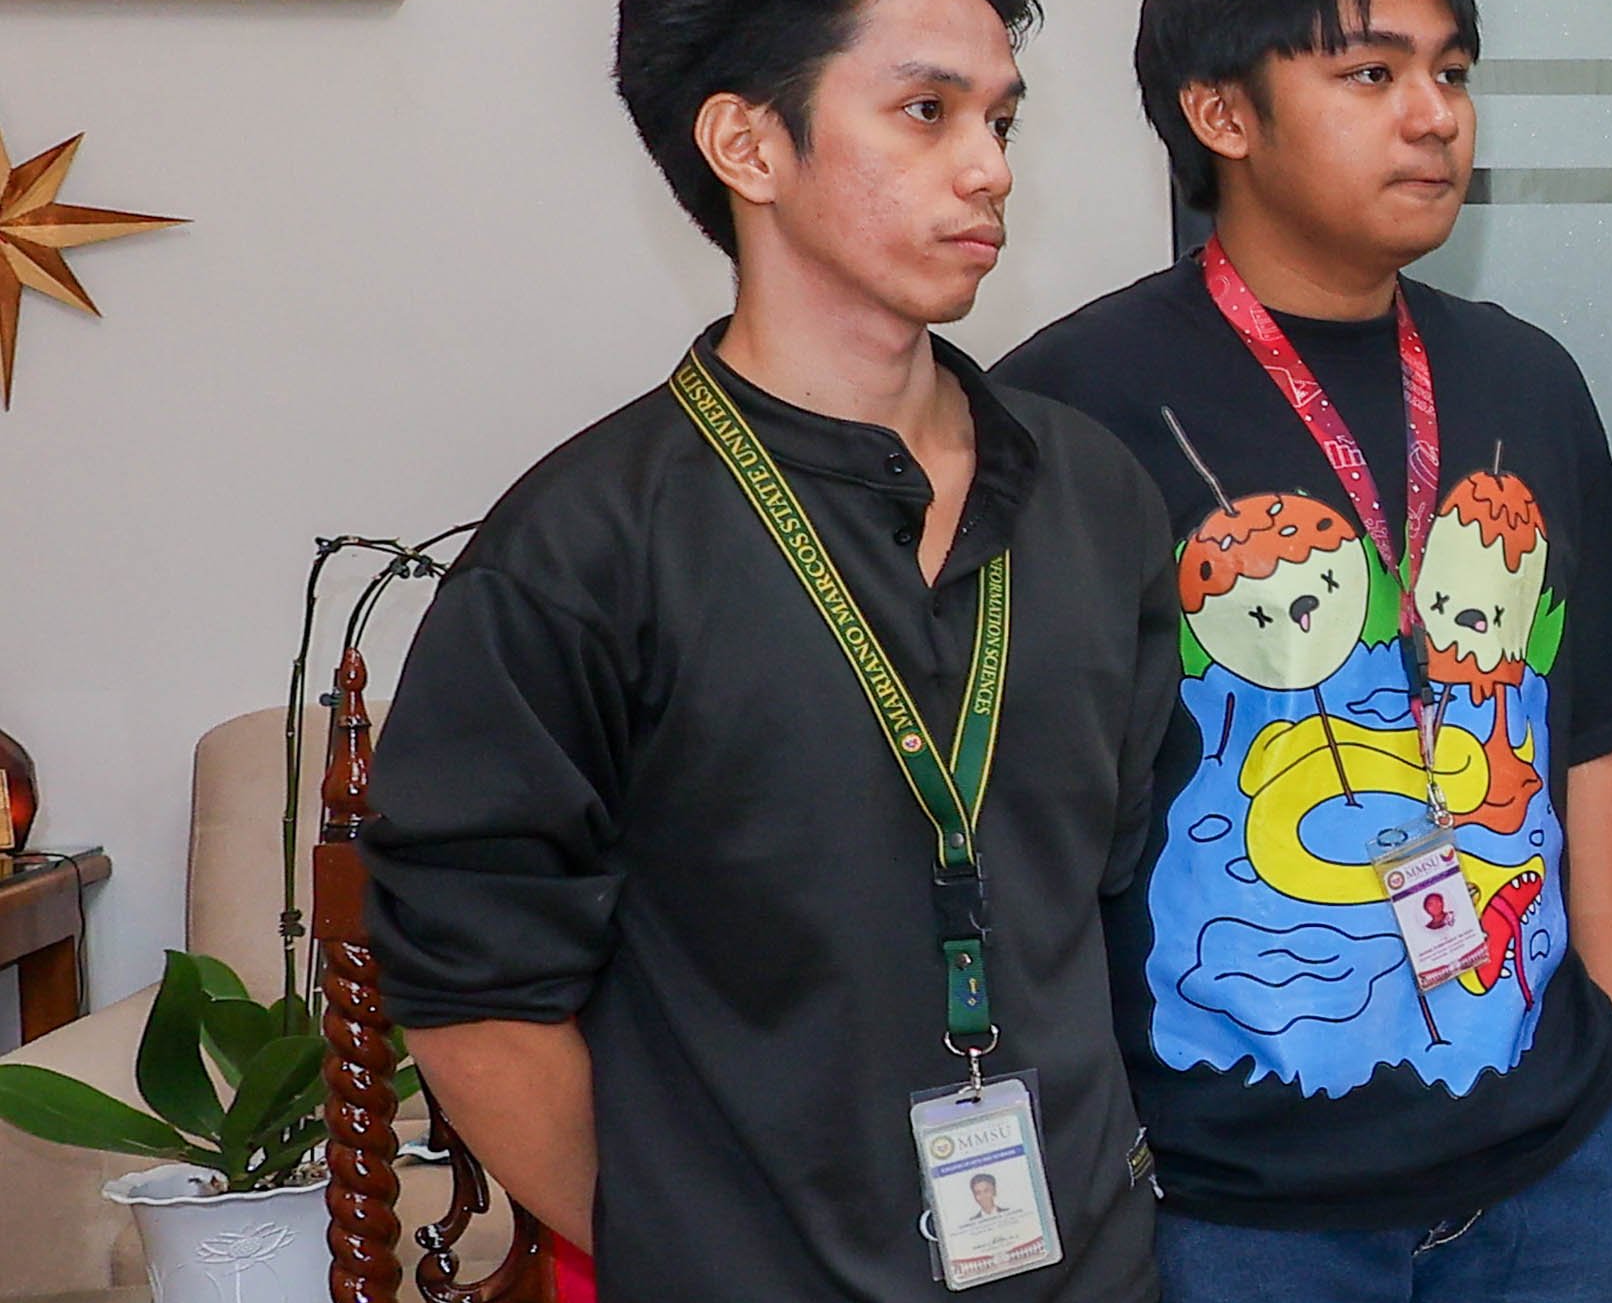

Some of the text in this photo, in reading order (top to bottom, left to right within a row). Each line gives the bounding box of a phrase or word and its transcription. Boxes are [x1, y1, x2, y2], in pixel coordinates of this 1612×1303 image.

[748, 464, 801, 534] STATE
[790, 531, 849, 624] MARCOS
[847, 623, 912, 731] MARIANO
[974, 647, 999, 715] SCIENCES
[1404, 854, 1441, 880] MMSU
[956, 1125, 1010, 1152] MMSU
